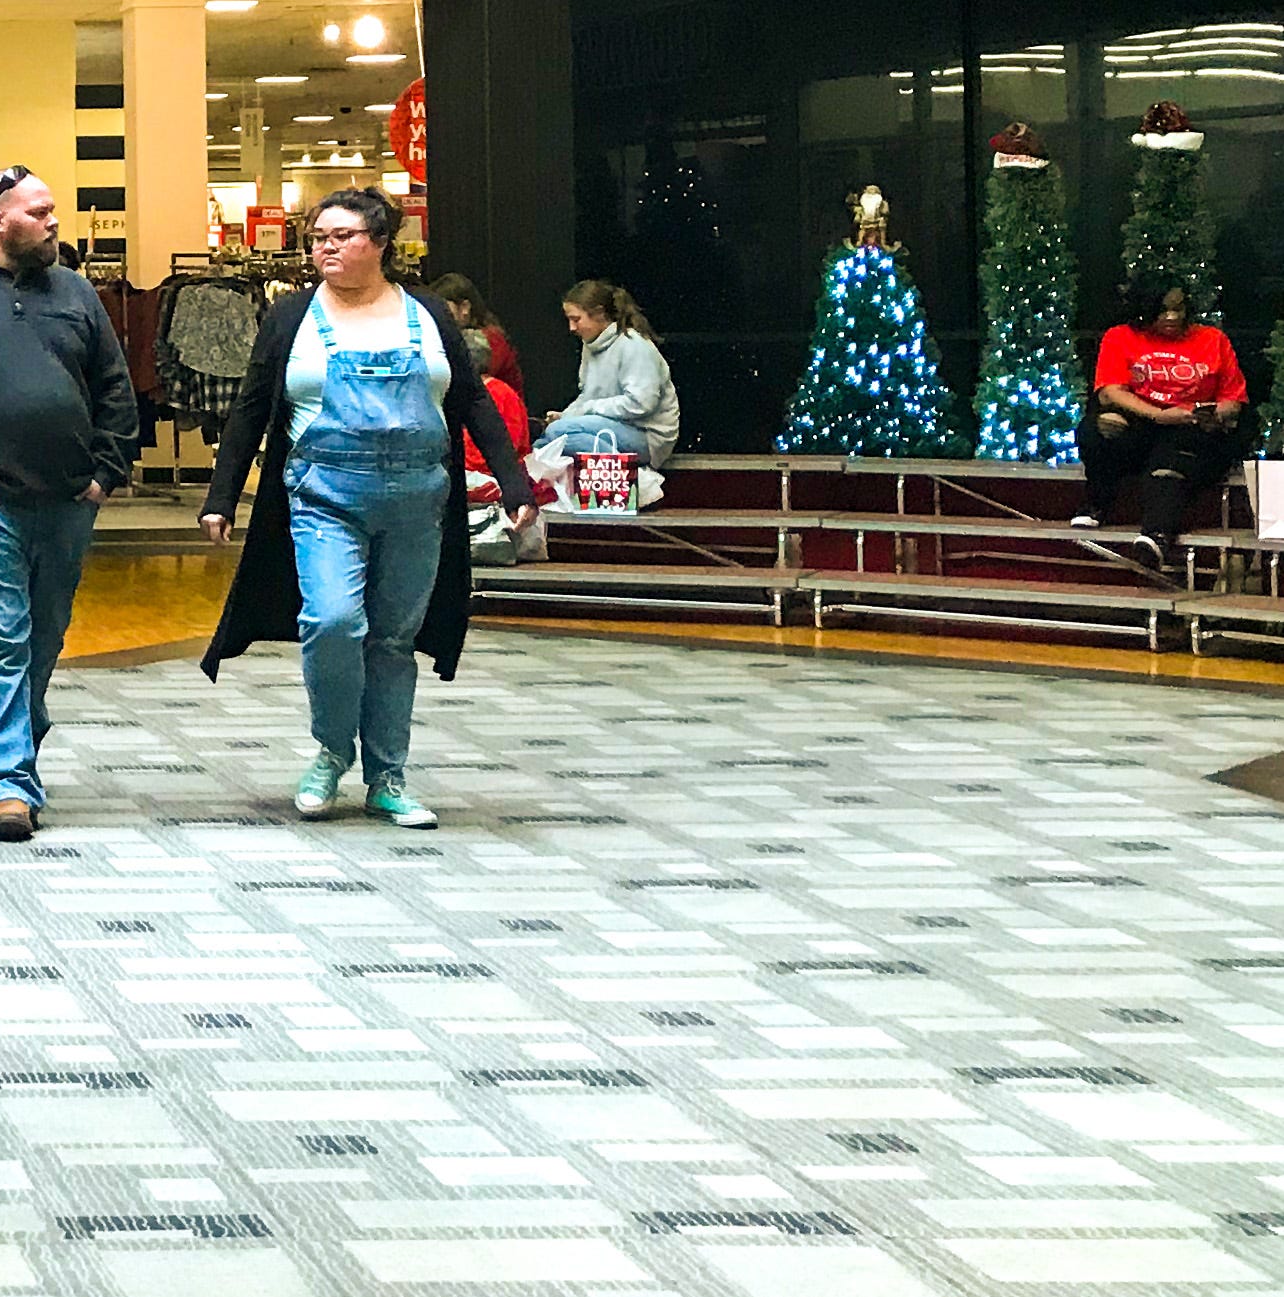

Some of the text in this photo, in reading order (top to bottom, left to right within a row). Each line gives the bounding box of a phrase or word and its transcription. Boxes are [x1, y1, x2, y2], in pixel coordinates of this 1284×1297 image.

[1132, 362, 1210, 383] SHOP
[586, 458, 622, 470] BATH
[579, 469, 630, 481] & BODY
[578, 480, 630, 492] WORKS
